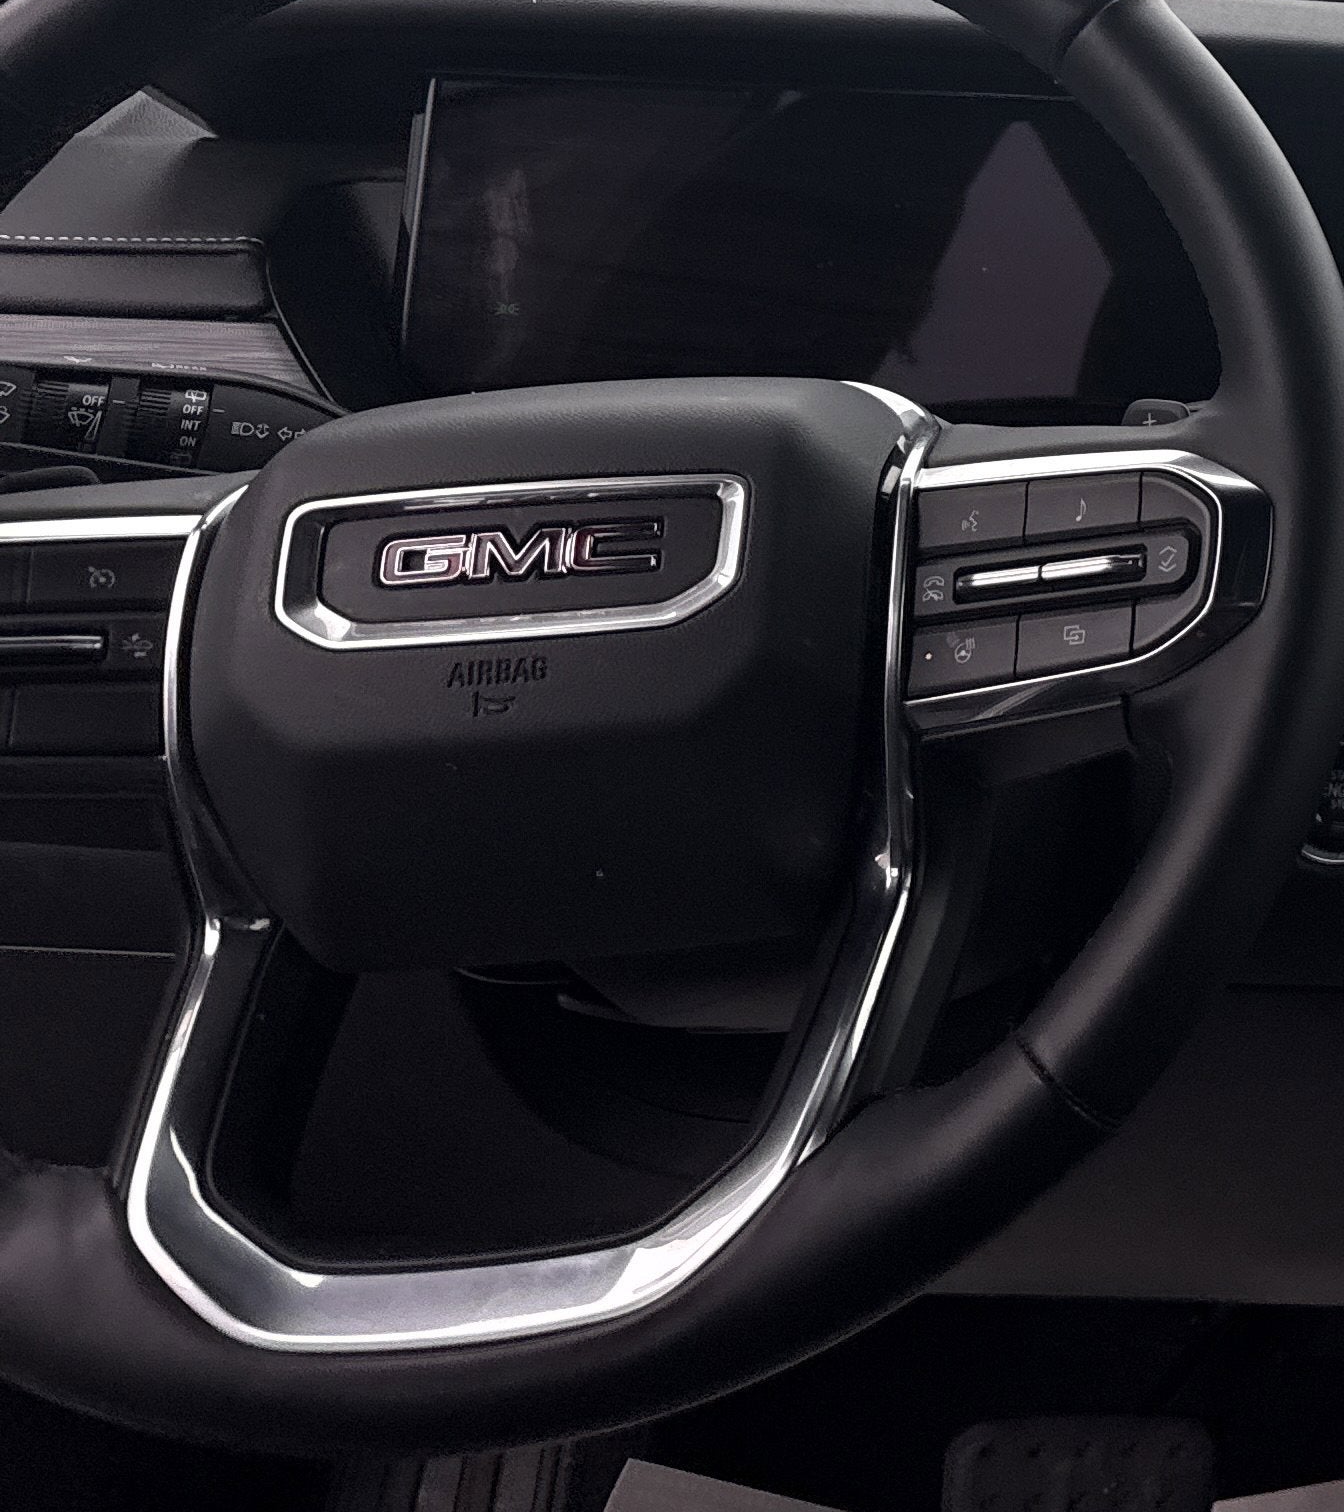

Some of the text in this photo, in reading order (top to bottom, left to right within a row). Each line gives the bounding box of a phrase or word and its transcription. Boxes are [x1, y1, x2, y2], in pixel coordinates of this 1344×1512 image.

[82, 395, 105, 407] OFF
[182, 404, 204, 416] OFF
[180, 419, 202, 431] INT
[179, 436, 196, 447] ON
[379, 519, 665, 586] GMC
[447, 656, 548, 689] AIRBAG
